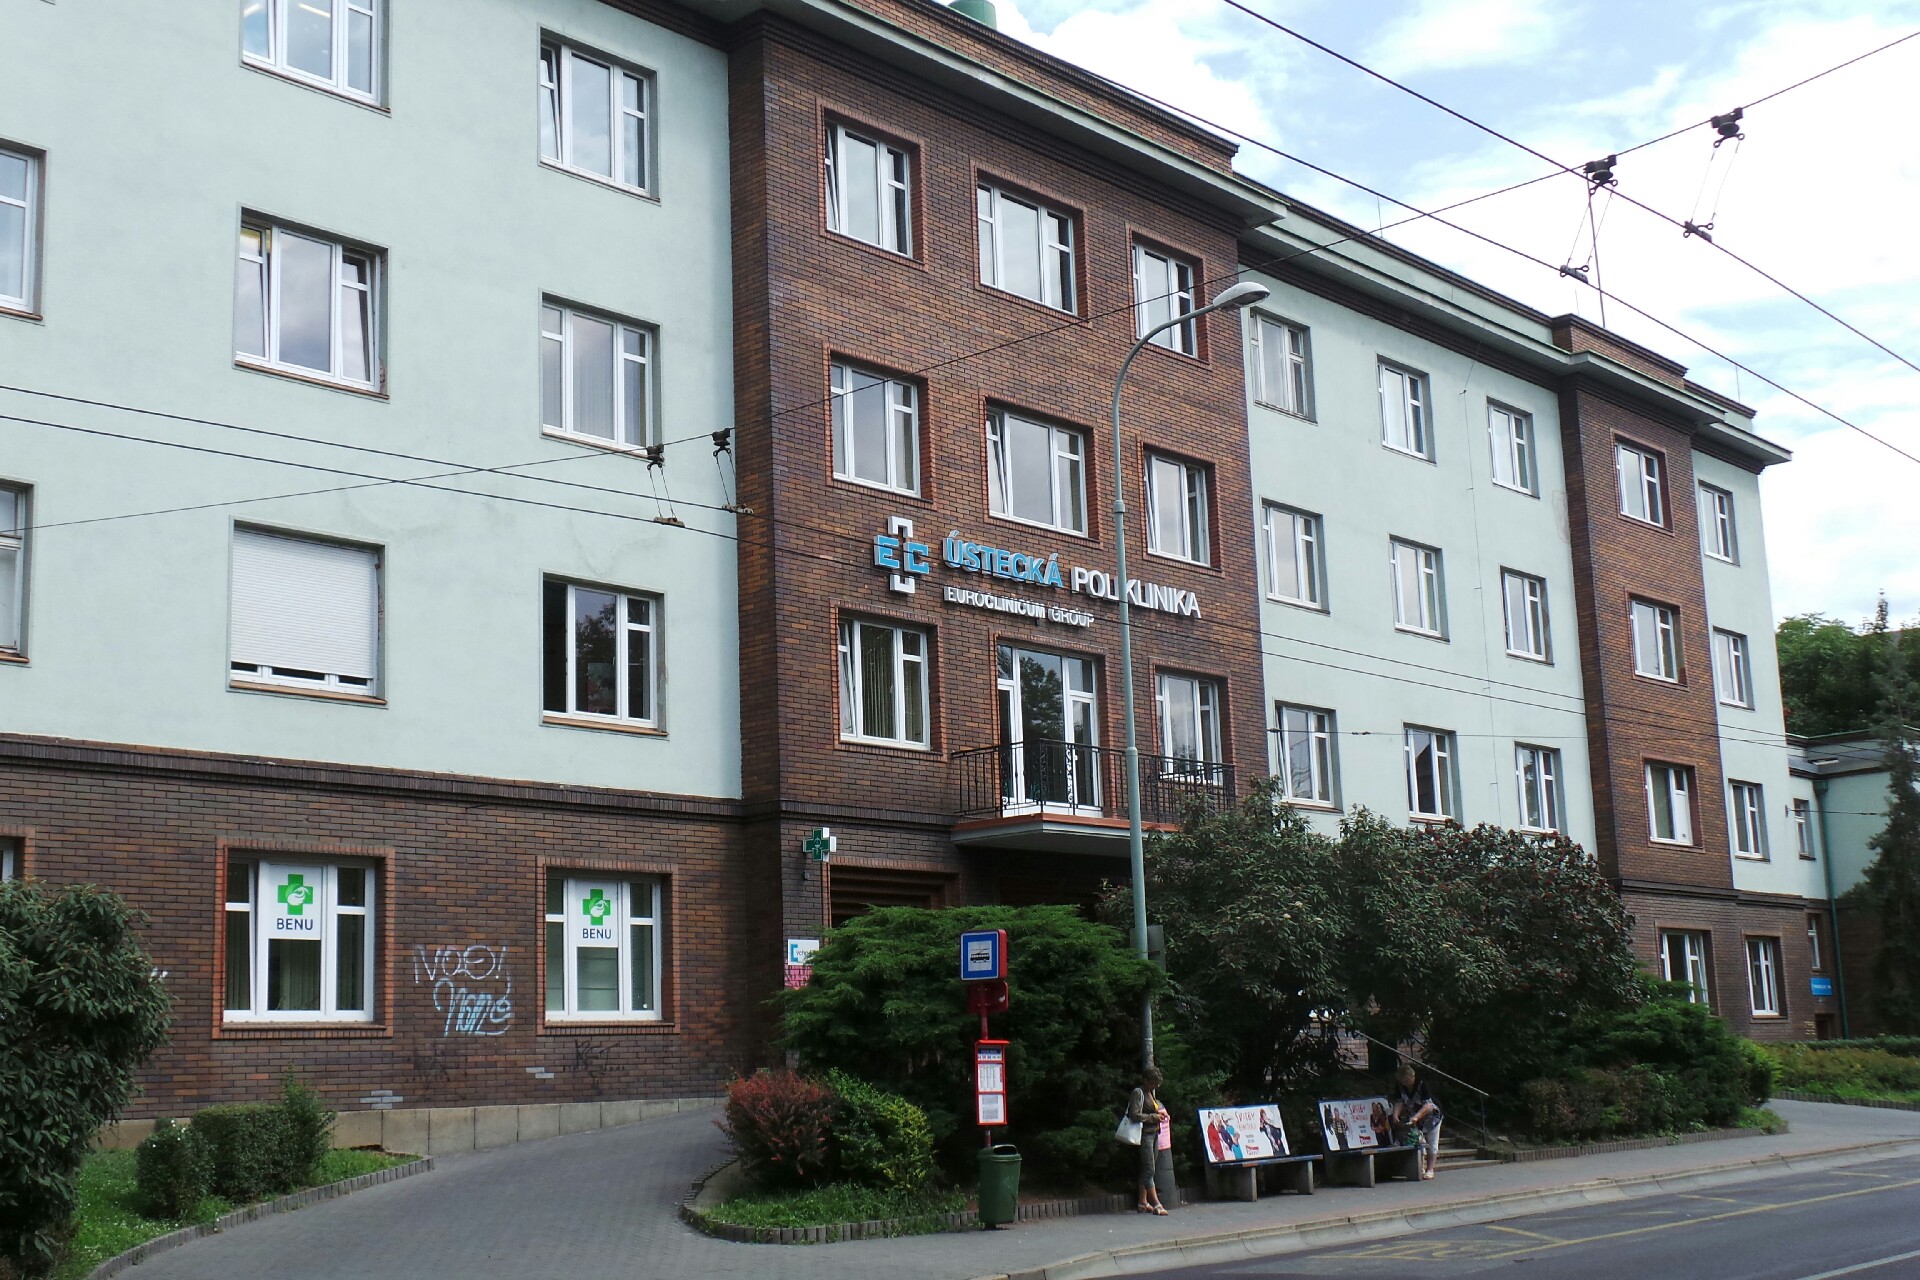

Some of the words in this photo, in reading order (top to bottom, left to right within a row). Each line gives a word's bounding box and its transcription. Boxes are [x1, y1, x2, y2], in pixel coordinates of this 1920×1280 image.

[943, 529, 1064, 589] ÚSTECKÁ
[943, 585, 1046, 618] EUROCLINICUM
[1048, 605, 1095, 628] GROUP
[276, 917, 314, 931] BENU
[582, 927, 612, 940] BENU
